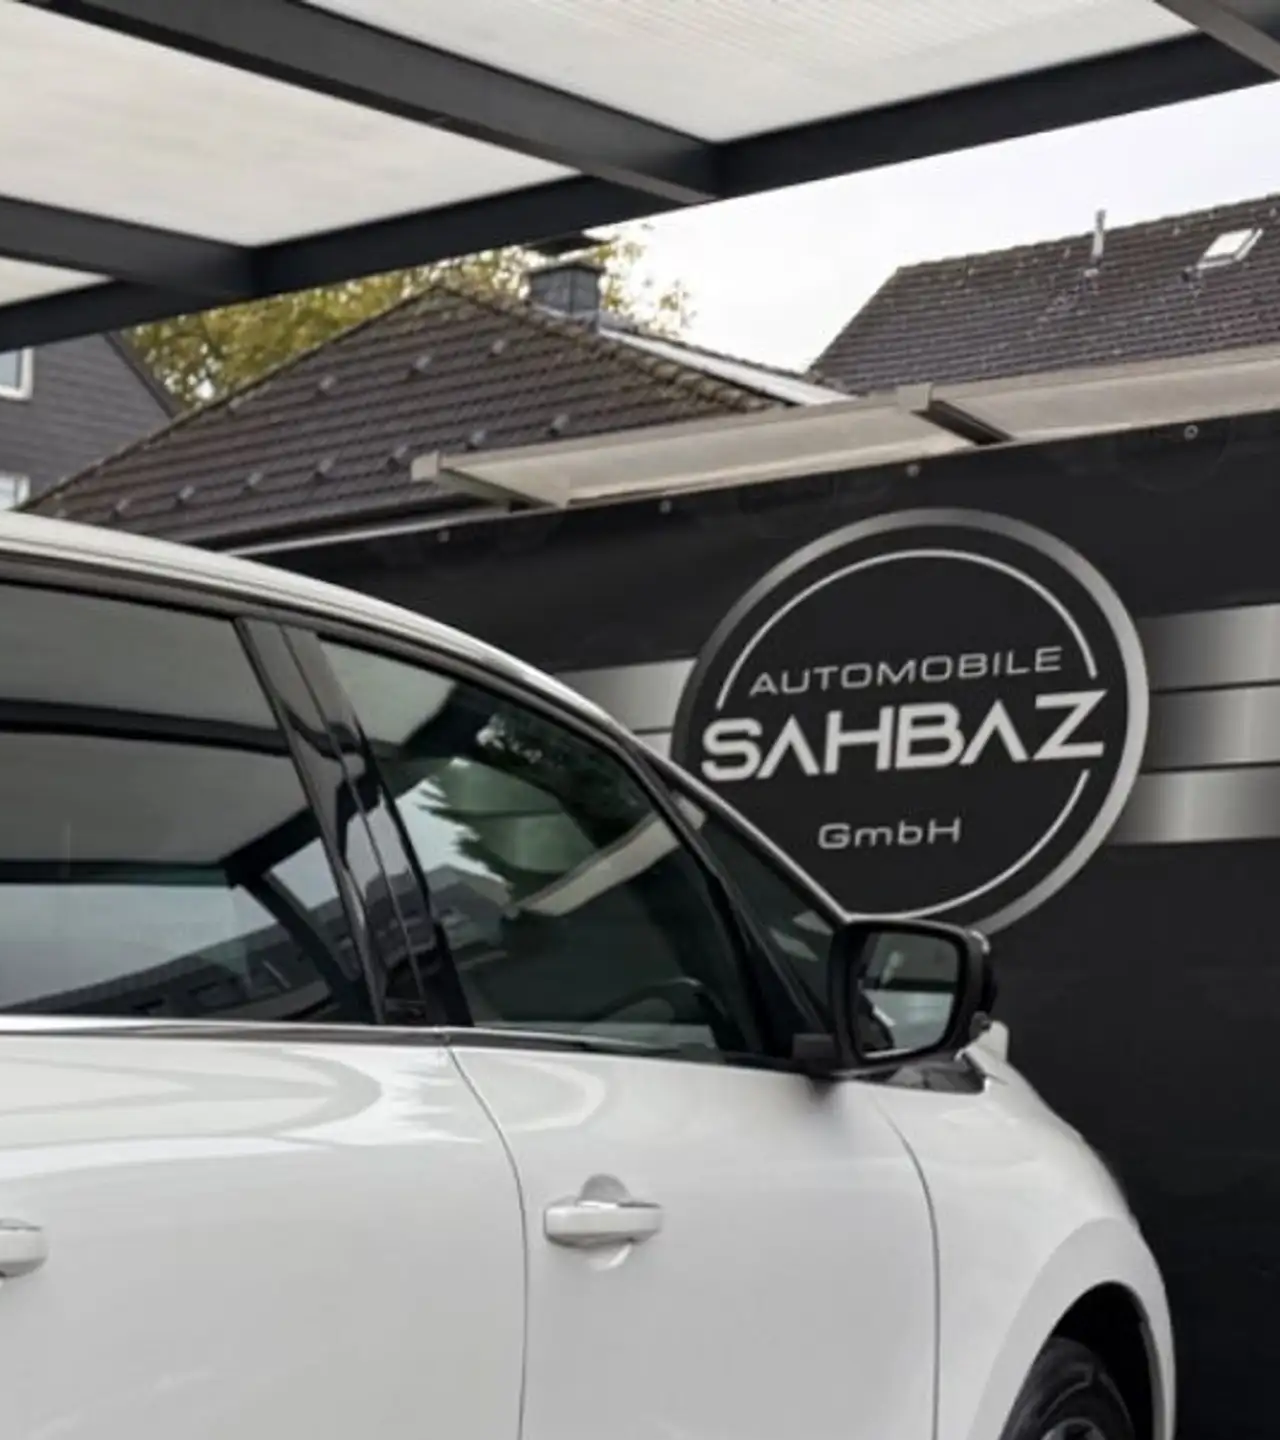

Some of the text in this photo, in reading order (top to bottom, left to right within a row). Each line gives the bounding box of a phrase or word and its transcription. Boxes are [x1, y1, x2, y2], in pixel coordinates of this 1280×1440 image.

[749, 647, 1063, 697] AUTOMOBILE
[701, 690, 1107, 782] SAHBAZ
[818, 818, 962, 850] GmbH
